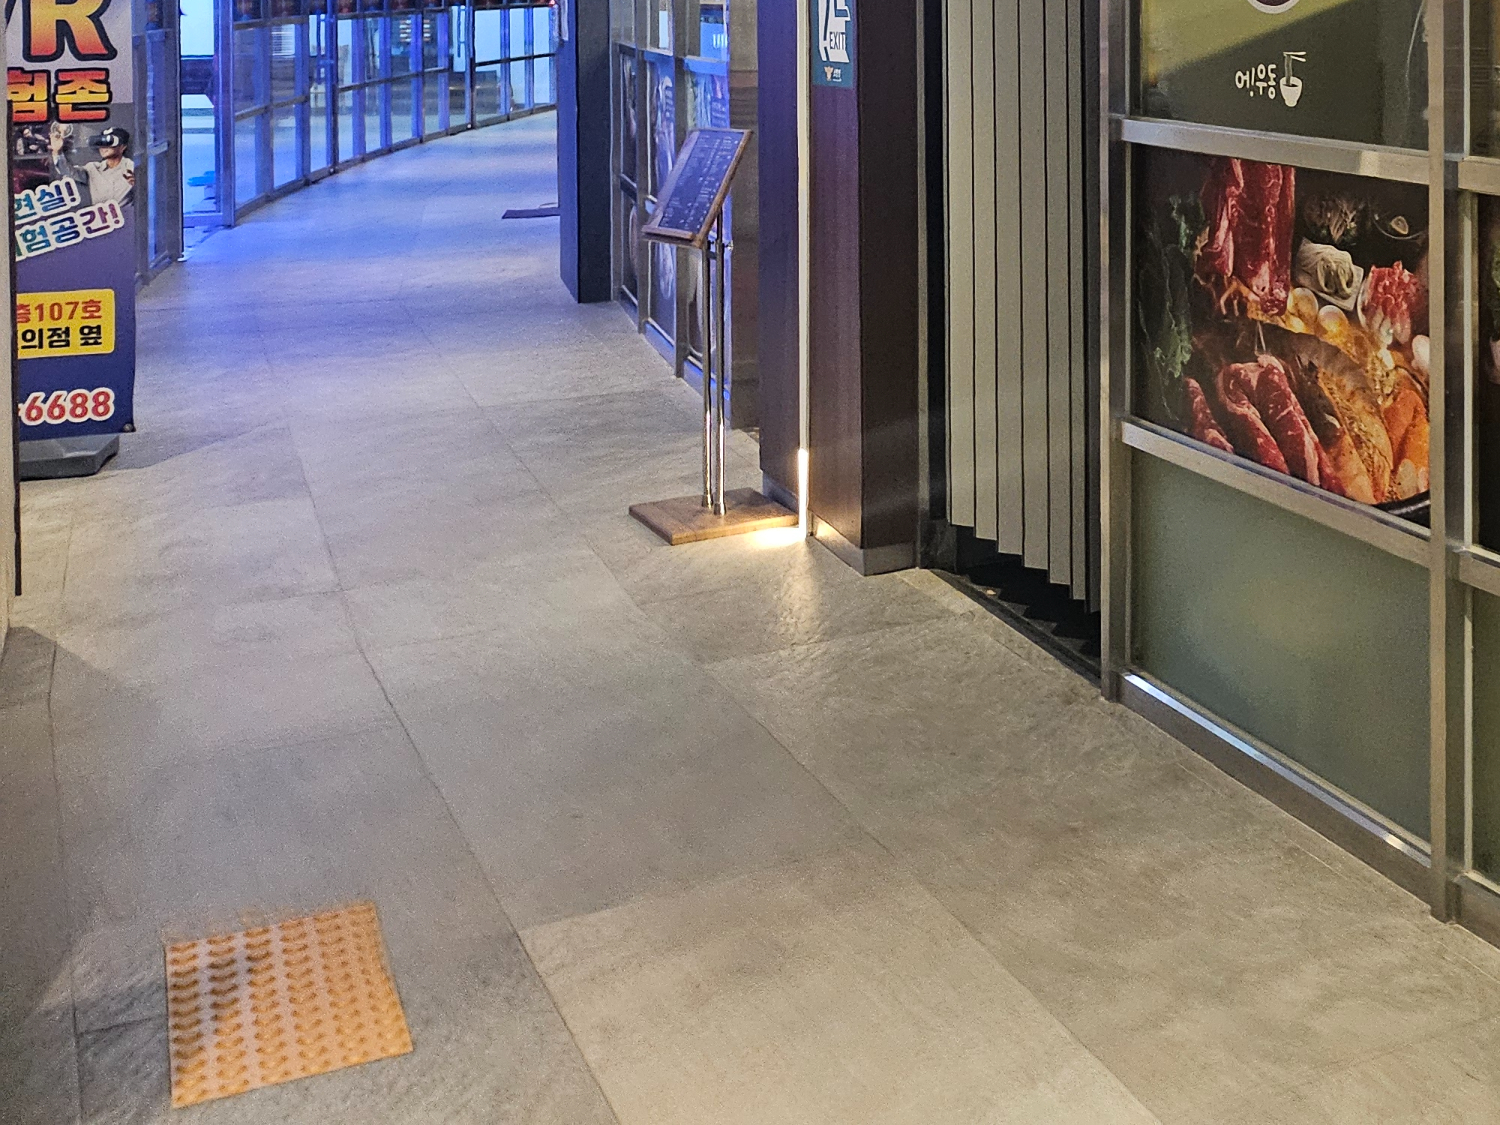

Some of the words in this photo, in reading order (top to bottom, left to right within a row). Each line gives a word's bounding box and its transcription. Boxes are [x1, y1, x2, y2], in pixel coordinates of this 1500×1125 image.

[829, 31, 847, 50] EXIT
[16, 203, 121, 257] 험공간!
[78, 324, 103, 347] 옆
